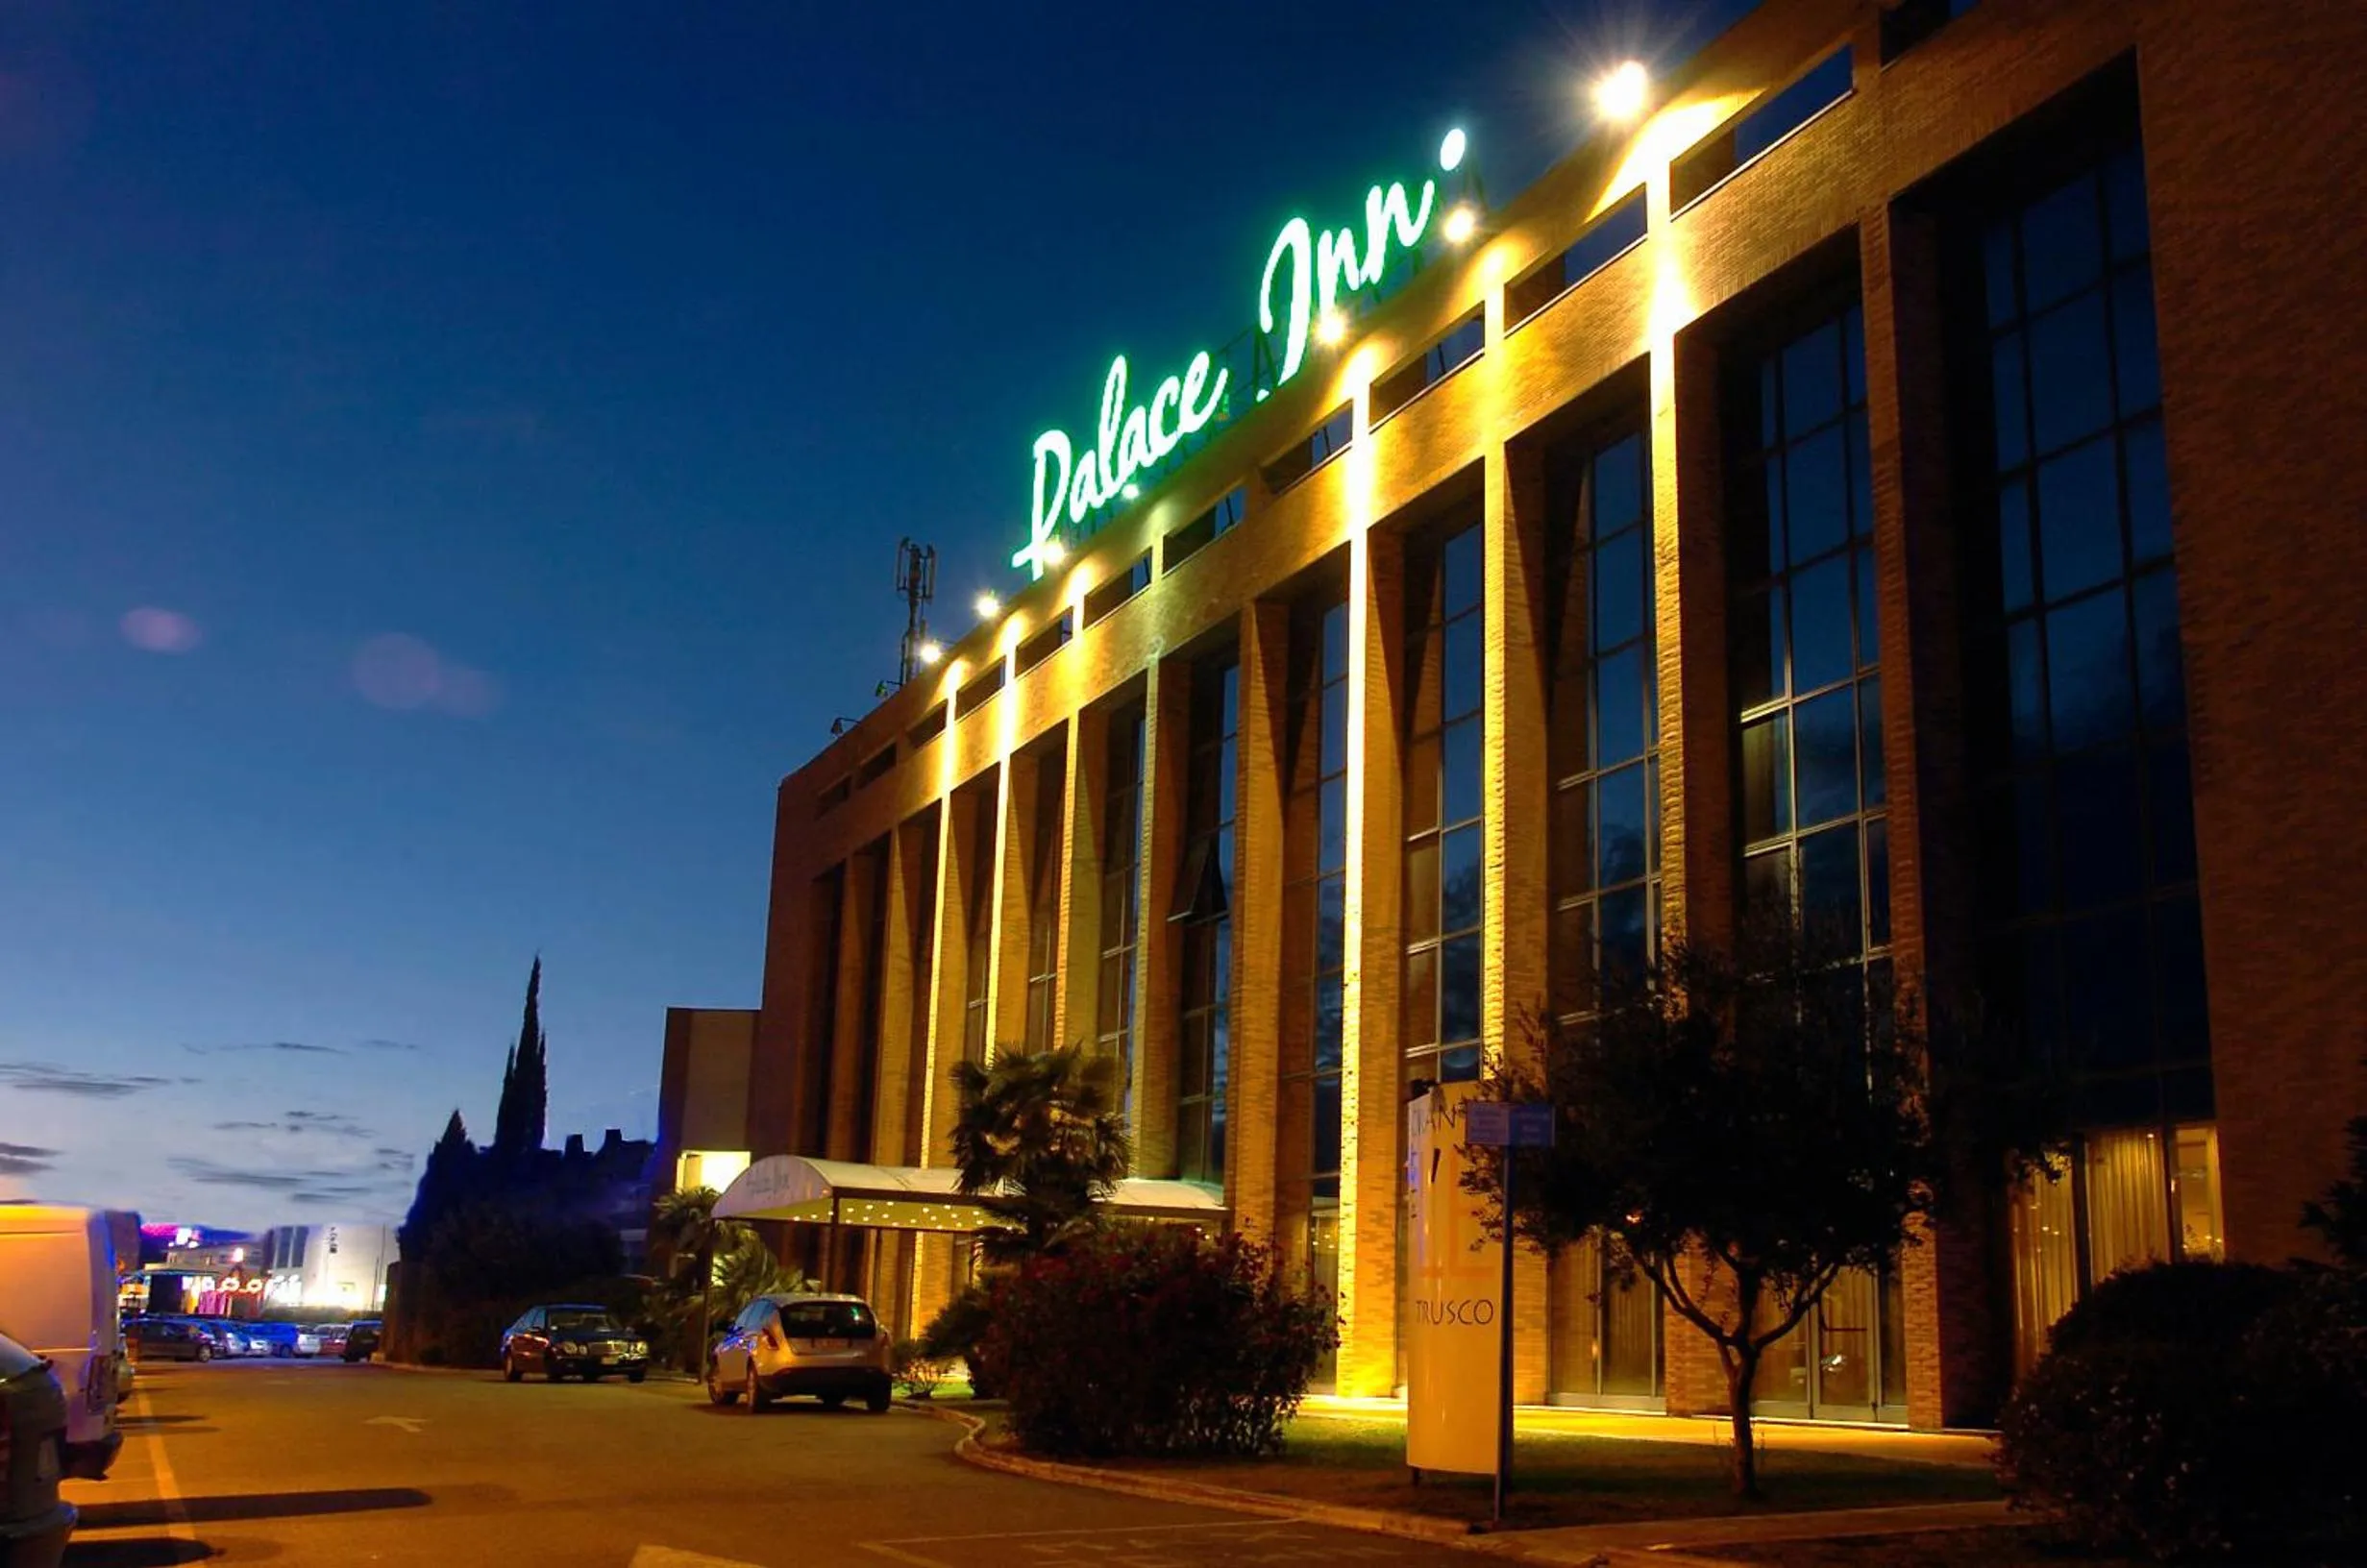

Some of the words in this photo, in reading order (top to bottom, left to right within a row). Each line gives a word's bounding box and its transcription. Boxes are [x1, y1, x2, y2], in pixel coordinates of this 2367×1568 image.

[1012, 352, 1228, 581] Palace
[1257, 180, 1435, 402] Inn
[1416, 1299, 1493, 1325] TRUSCO
